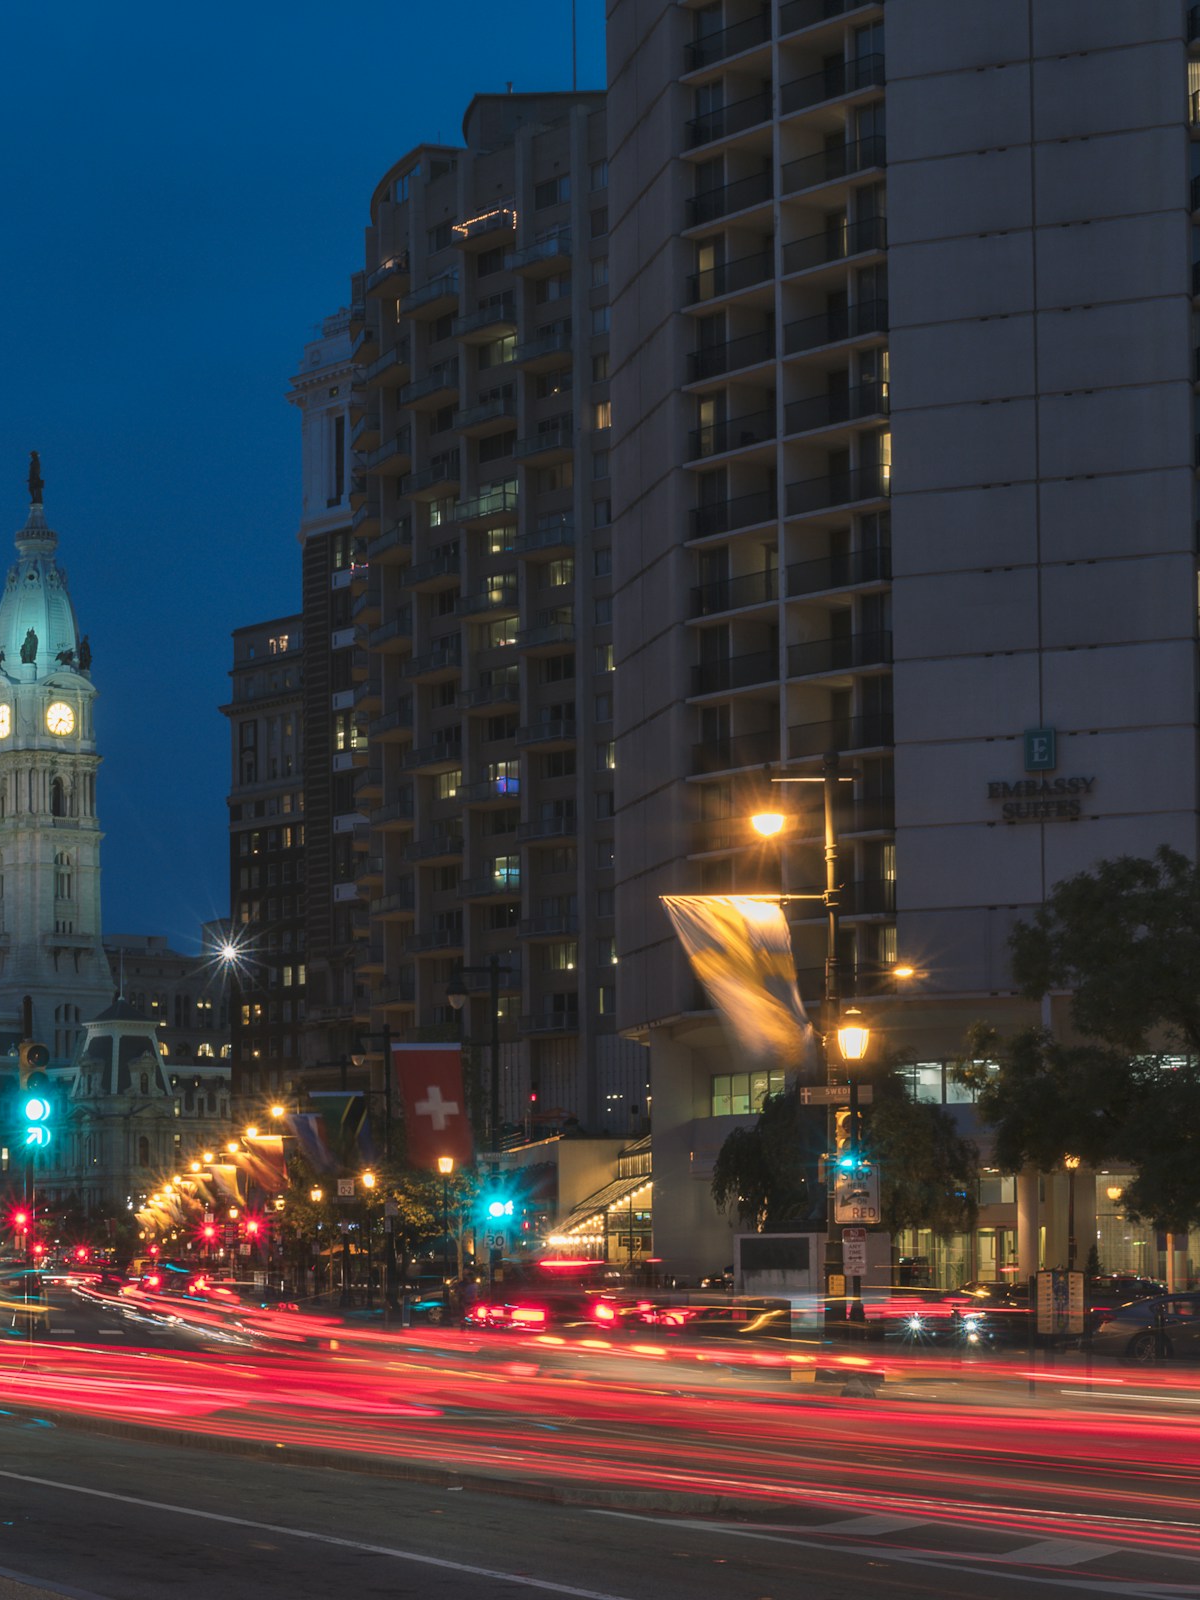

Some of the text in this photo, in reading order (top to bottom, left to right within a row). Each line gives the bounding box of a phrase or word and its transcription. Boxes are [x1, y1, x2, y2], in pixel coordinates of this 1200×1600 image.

[1032, 737, 1048, 762] E
[987, 776, 1096, 799] EMBASSY
[1002, 799, 1081, 819] SUITES
[841, 1168, 873, 1181] STOP
[852, 1207, 876, 1218] RED
[487, 1235, 504, 1247] 30
